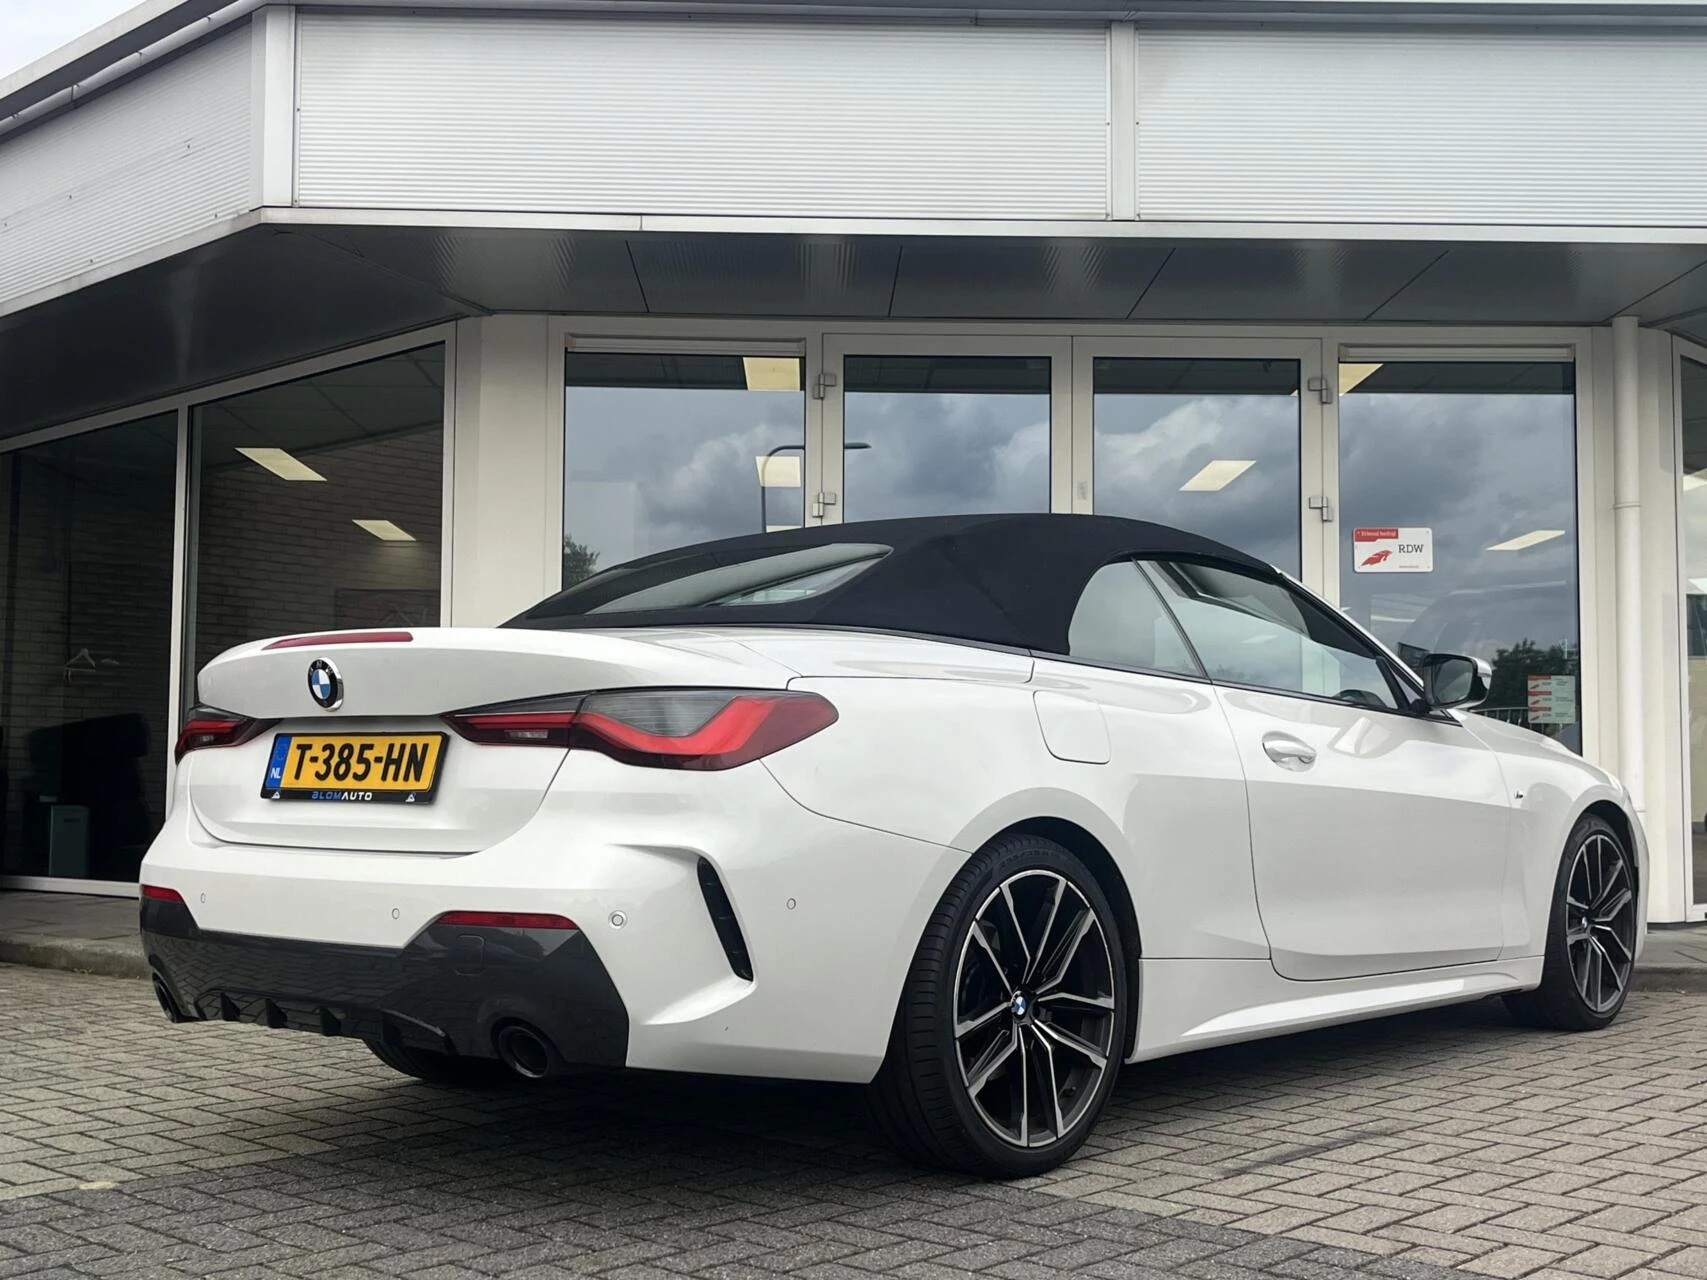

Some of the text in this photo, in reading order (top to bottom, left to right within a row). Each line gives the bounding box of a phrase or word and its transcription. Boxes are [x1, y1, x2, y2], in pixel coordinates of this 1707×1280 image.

[1398, 544, 1424, 554] RDW
[294, 743, 429, 782] T-385-HN
[270, 767, 281, 779] NL
